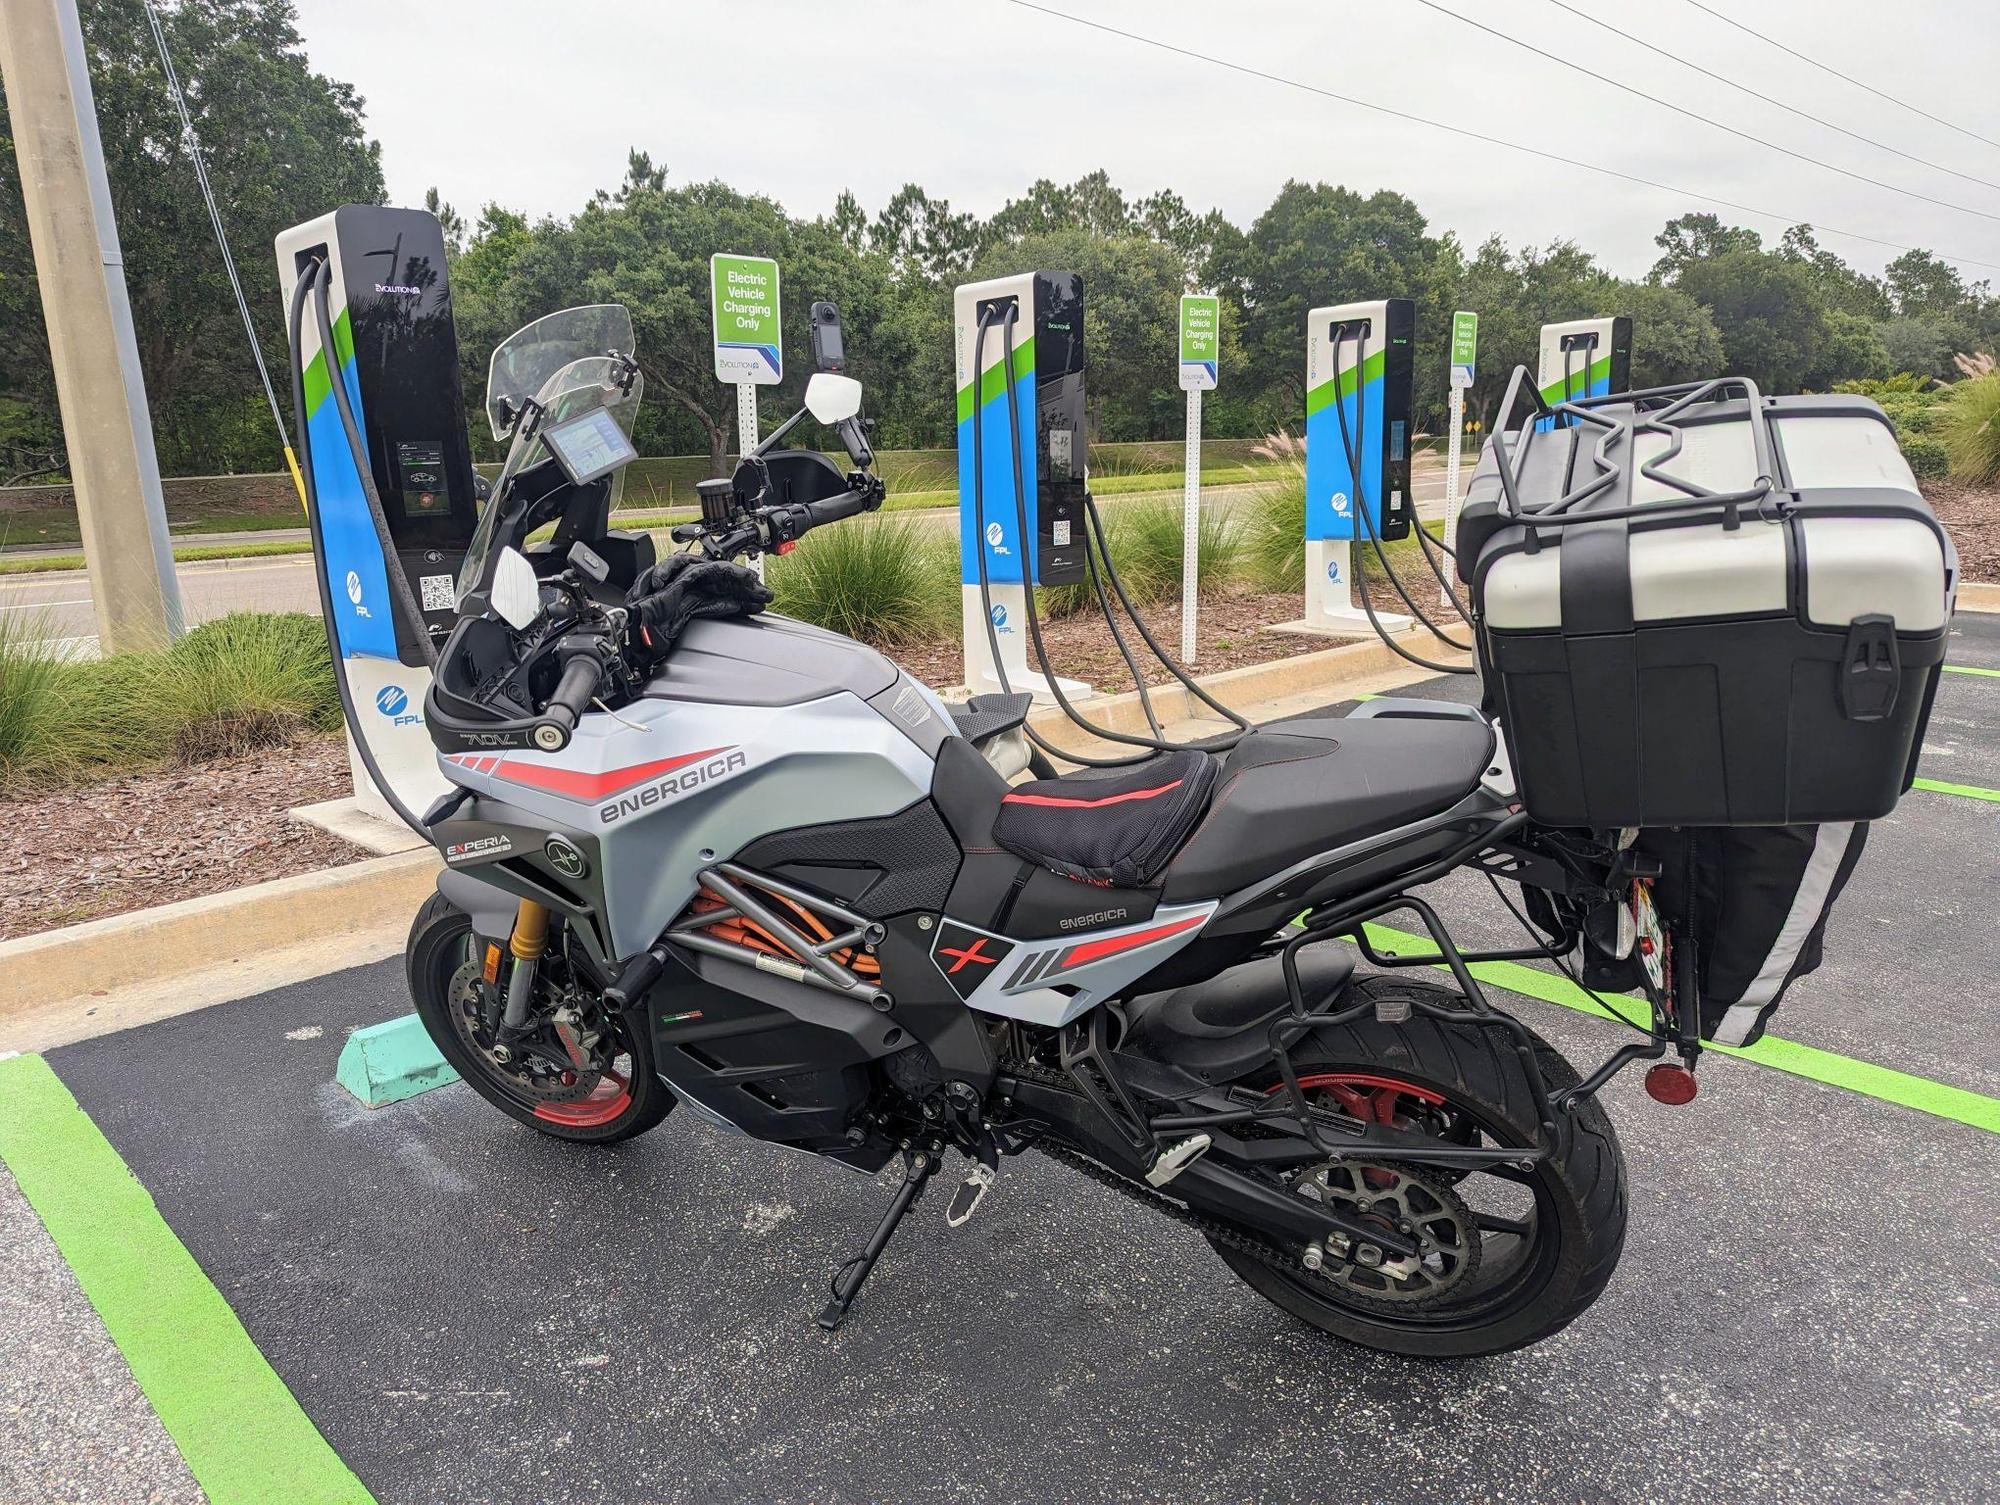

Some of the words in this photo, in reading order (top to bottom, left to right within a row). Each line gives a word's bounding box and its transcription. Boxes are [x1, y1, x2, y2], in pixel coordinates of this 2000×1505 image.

[728, 271, 767, 285] Electric
[728, 287, 765, 300] Vehicle
[723, 301, 771, 317] Charging
[1189, 307, 1212, 317] Electric
[736, 317, 760, 331] Only
[1189, 319, 1210, 328] Vehicle
[1186, 329, 1213, 340] Charging
[1192, 341, 1206, 351] Only
[995, 546, 1012, 554] FPL
[356, 605, 373, 617] FPL
[394, 713, 425, 726] FPL
[447, 834, 511, 856] EXPERIA
